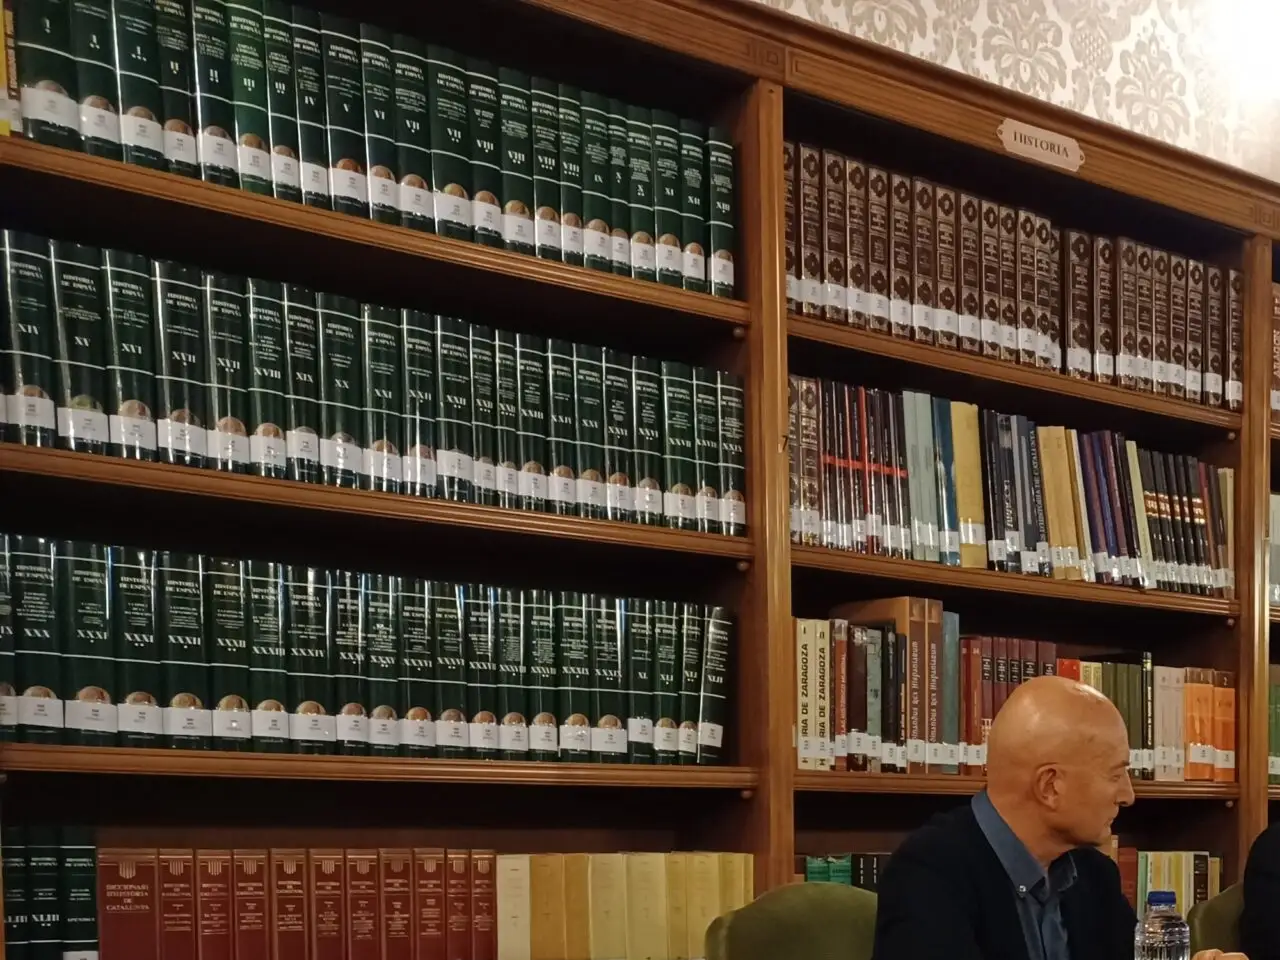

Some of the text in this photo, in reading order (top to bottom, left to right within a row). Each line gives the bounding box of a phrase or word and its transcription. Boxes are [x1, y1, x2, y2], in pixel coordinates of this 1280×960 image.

[1013, 130, 1069, 158] HISTORIA
[802, 702, 808, 715] DE
[819, 705, 826, 718] DE
